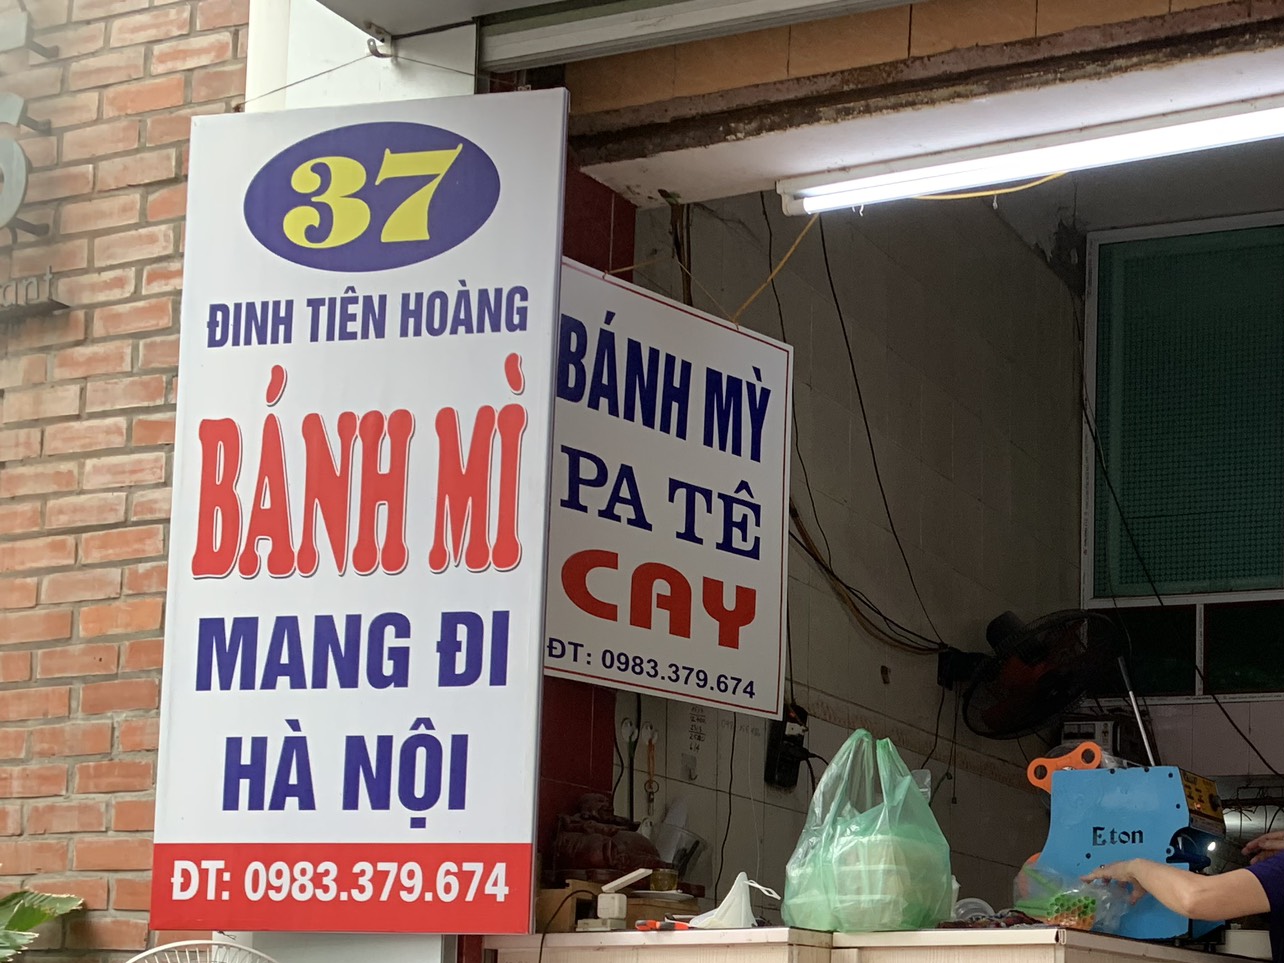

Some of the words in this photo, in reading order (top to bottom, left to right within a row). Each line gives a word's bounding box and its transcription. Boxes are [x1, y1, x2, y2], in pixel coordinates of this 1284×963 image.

[283, 144, 463, 248] 37
[207, 299, 294, 348] ĐINH
[306, 286, 388, 343] TIÊN
[400, 279, 529, 338] HOÀNG
[557, 310, 692, 441] BÁNH
[703, 365, 771, 463] MỲ
[191, 364, 415, 579] BÁNH
[428, 352, 527, 574] MÌ
[560, 444, 652, 532] PA
[668, 477, 761, 561] TÊ
[561, 549, 756, 649] CAY
[196, 612, 411, 691] MANG
[436, 610, 510, 687] ĐI
[547, 637, 592, 665] ĐT:
[601, 649, 755, 699] 0983.379.674
[222, 718, 316, 811] HÀ
[342, 717, 469, 829] NỘI
[171, 859, 231, 901] ĐT:
[244, 861, 509, 902] 0983.379.674
[1092, 826, 1144, 847] Eton
